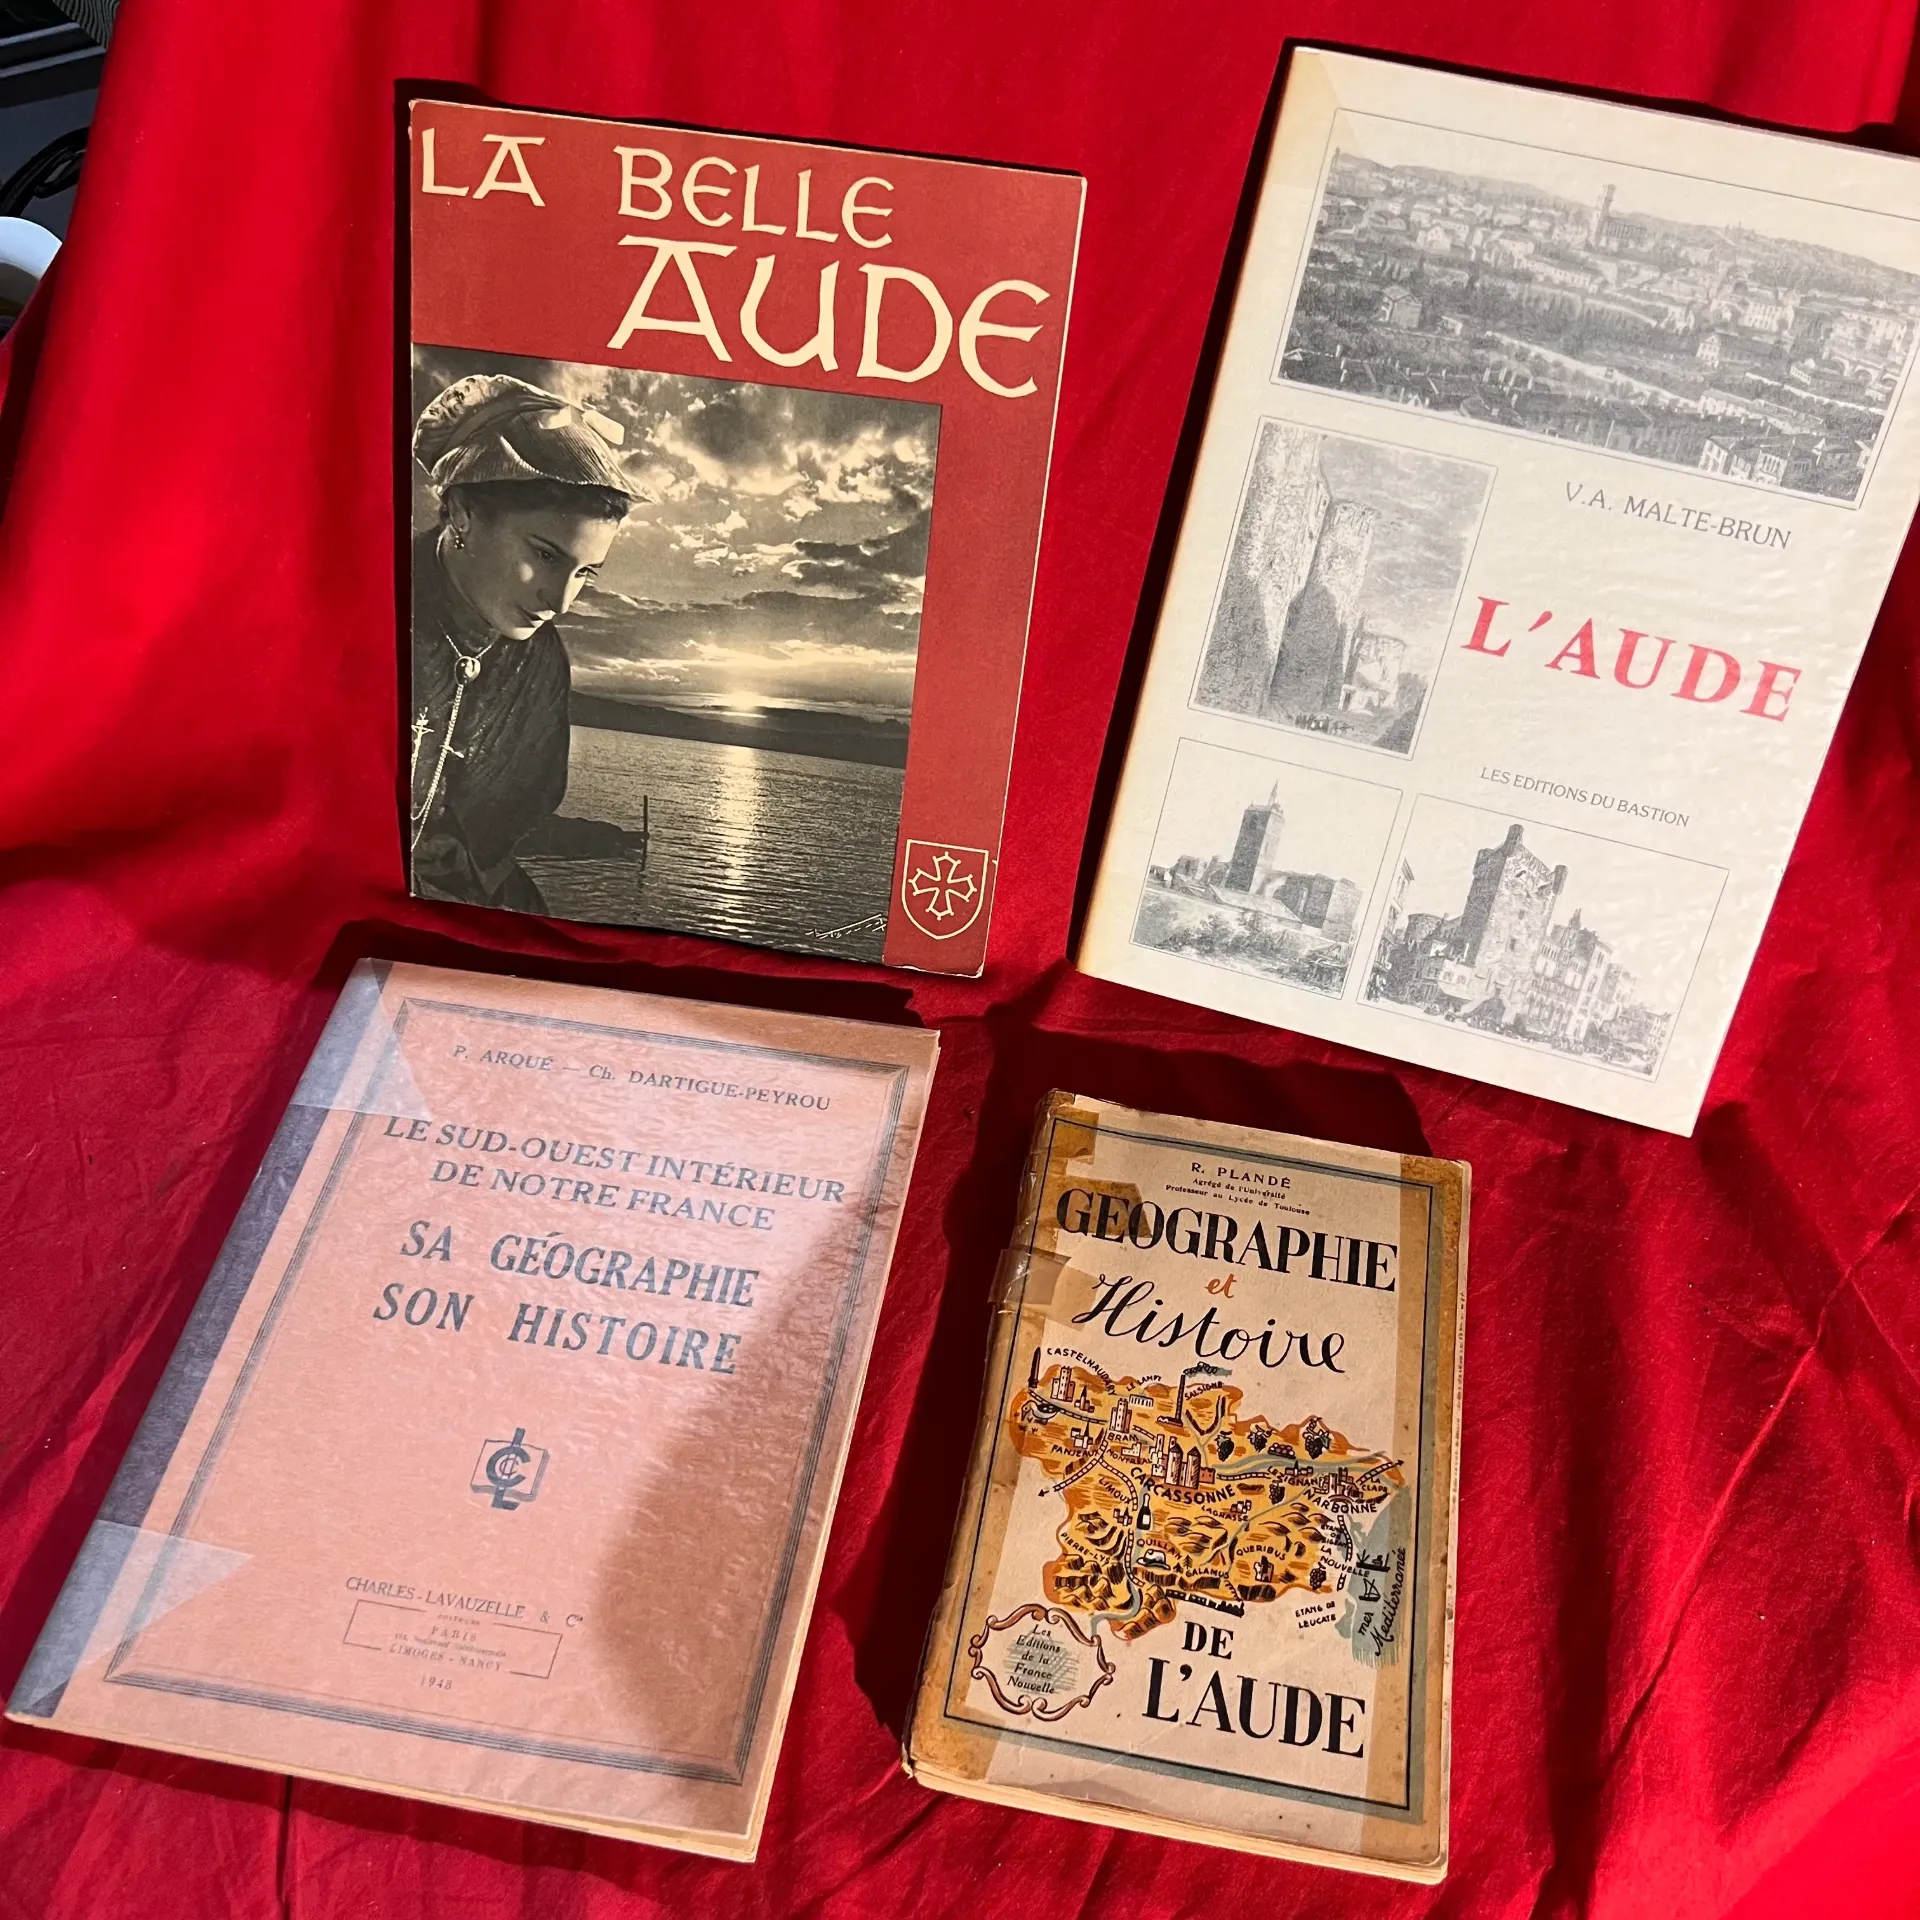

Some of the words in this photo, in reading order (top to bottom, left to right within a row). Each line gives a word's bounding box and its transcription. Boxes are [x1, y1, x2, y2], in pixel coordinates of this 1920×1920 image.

[420, 127, 546, 207] LA
[613, 145, 895, 249] BELLE
[606, 234, 1051, 398] AUDE
[1566, 482, 1612, 511] V.A.
[1623, 496, 1791, 550] MALTE-BRUN
[1460, 596, 1802, 722] L'AUDE
[1480, 766, 1510, 784] LES
[1513, 774, 1588, 803] EDITIONS
[1591, 792, 1615, 810] DU
[1617, 799, 1690, 828] BASTION
[452, 1045, 469, 1060] P.
[480, 1049, 554, 1072] ARQUÉ
[589, 1064, 616, 1081] Ch.
[628, 1070, 831, 1111] DARTIGUE-PEYROU
[383, 1115, 430, 1142] LE
[436, 1124, 641, 1173] SUD-OUEST
[647, 1154, 846, 1203] INTÉRIEUR
[1191, 1162, 1205, 1173] R.
[1217, 1167, 1291, 1189] PLANDÉ
[1225, 1183, 1235, 1191] de
[431, 1160, 485, 1187] DE
[490, 1168, 620, 1208] NOTRE
[626, 1189, 776, 1231] FRANCE
[1165, 1184, 1209, 1196] Professeur
[1274, 1202, 1310, 1215] Toulouse
[1056, 1188, 1398, 1292] GEOGRAPHIE
[400, 1220, 452, 1262] SA
[489, 1231, 760, 1308] GÉOGRAPHIE
[1205, 1273, 1235, 1298] et
[373, 1282, 475, 1333] SON
[507, 1302, 742, 1375] HISTOIRE
[1072, 1273, 1346, 1373] Histoire
[1107, 1432, 1139, 1443] BRAM
[1098, 1477, 1131, 1505] LIMOUX
[1130, 1466, 1236, 1505] CARCASSONNE
[1303, 1489, 1378, 1514] NARBONNE
[1137, 1538, 1183, 1560] QUILLAN
[1320, 1545, 1332, 1555] LA
[1320, 1556, 1370, 1577] NOUVELLE
[539, 1610, 550, 1624] &
[1032, 1624, 1051, 1637] Les
[1358, 1612, 1374, 1637] mer
[431, 1626, 477, 1641] PARIS
[1181, 1620, 1234, 1660] DE
[1014, 1662, 1053, 1679] France
[1021, 1650, 1034, 1661] de
[1039, 1653, 1050, 1665] la
[1007, 1675, 1055, 1694] Nouvelle
[1142, 1657, 1366, 1759] L'AUDE
